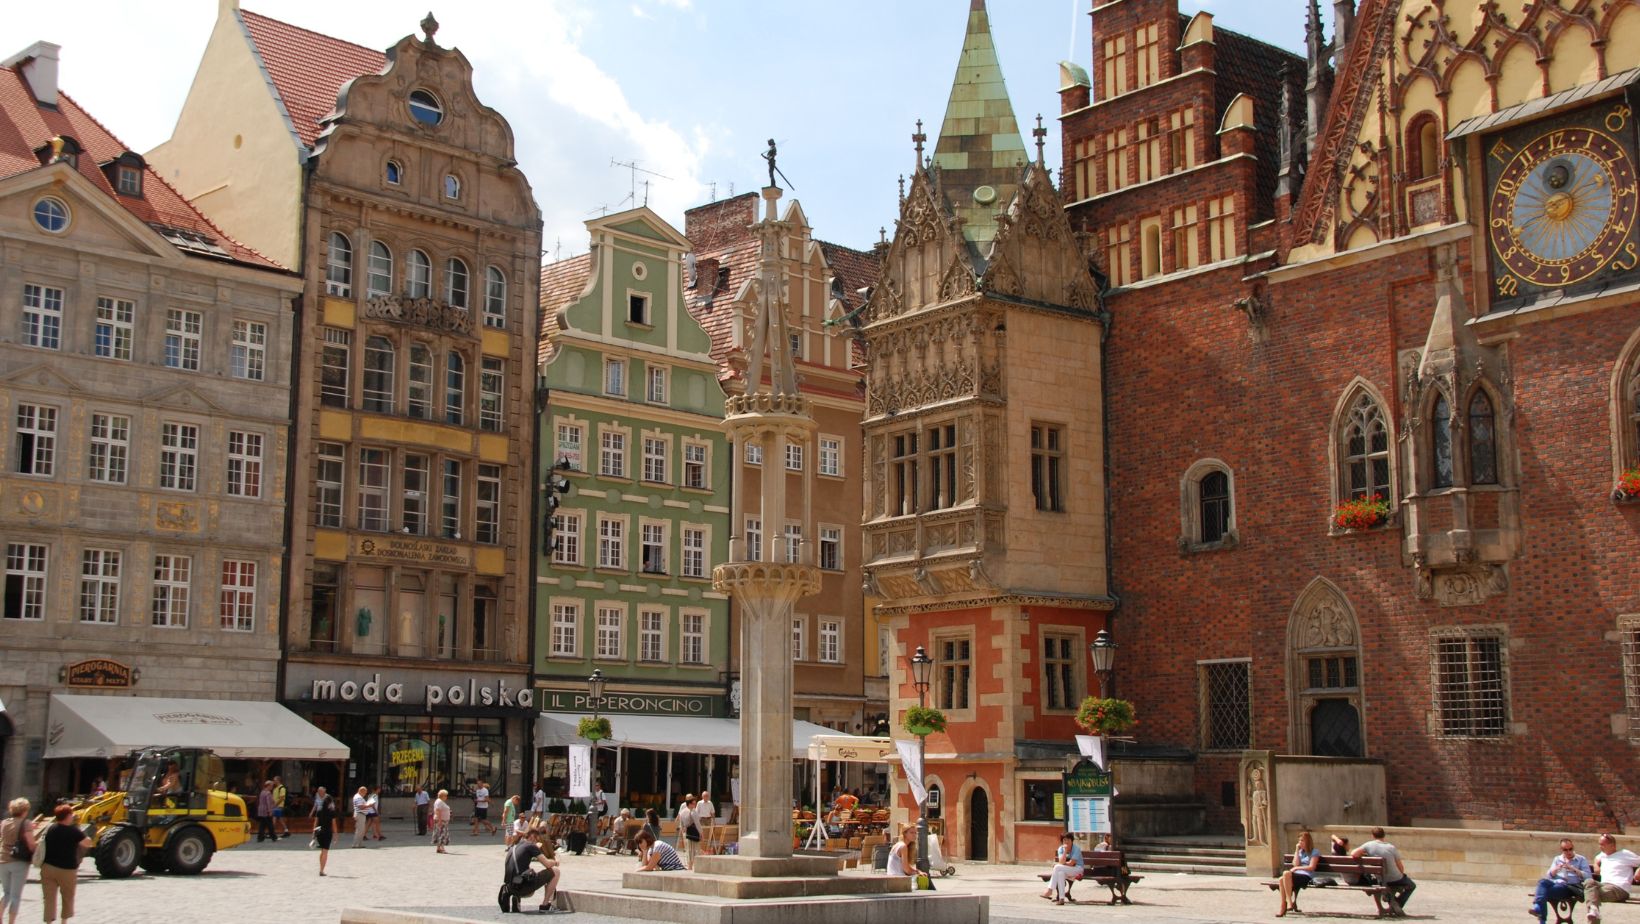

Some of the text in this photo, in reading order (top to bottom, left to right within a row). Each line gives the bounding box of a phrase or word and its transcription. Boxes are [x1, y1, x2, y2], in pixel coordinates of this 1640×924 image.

[1548, 131, 1567, 151] 12
[1583, 132, 1594, 149] 1
[1519, 150, 1535, 169] 11
[1497, 178, 1515, 198] 10
[1617, 184, 1636, 197] 3
[1612, 220, 1627, 234] 4
[1503, 246, 1517, 260] 8
[1591, 249, 1605, 267] 5
[1527, 264, 1541, 280] 7
[71, 661, 128, 678] PIEROGARNIA
[312, 673, 534, 712] moda polska
[552, 694, 703, 712] IL PEPERONCINO
[392, 749, 425, 765] PRZECENA
